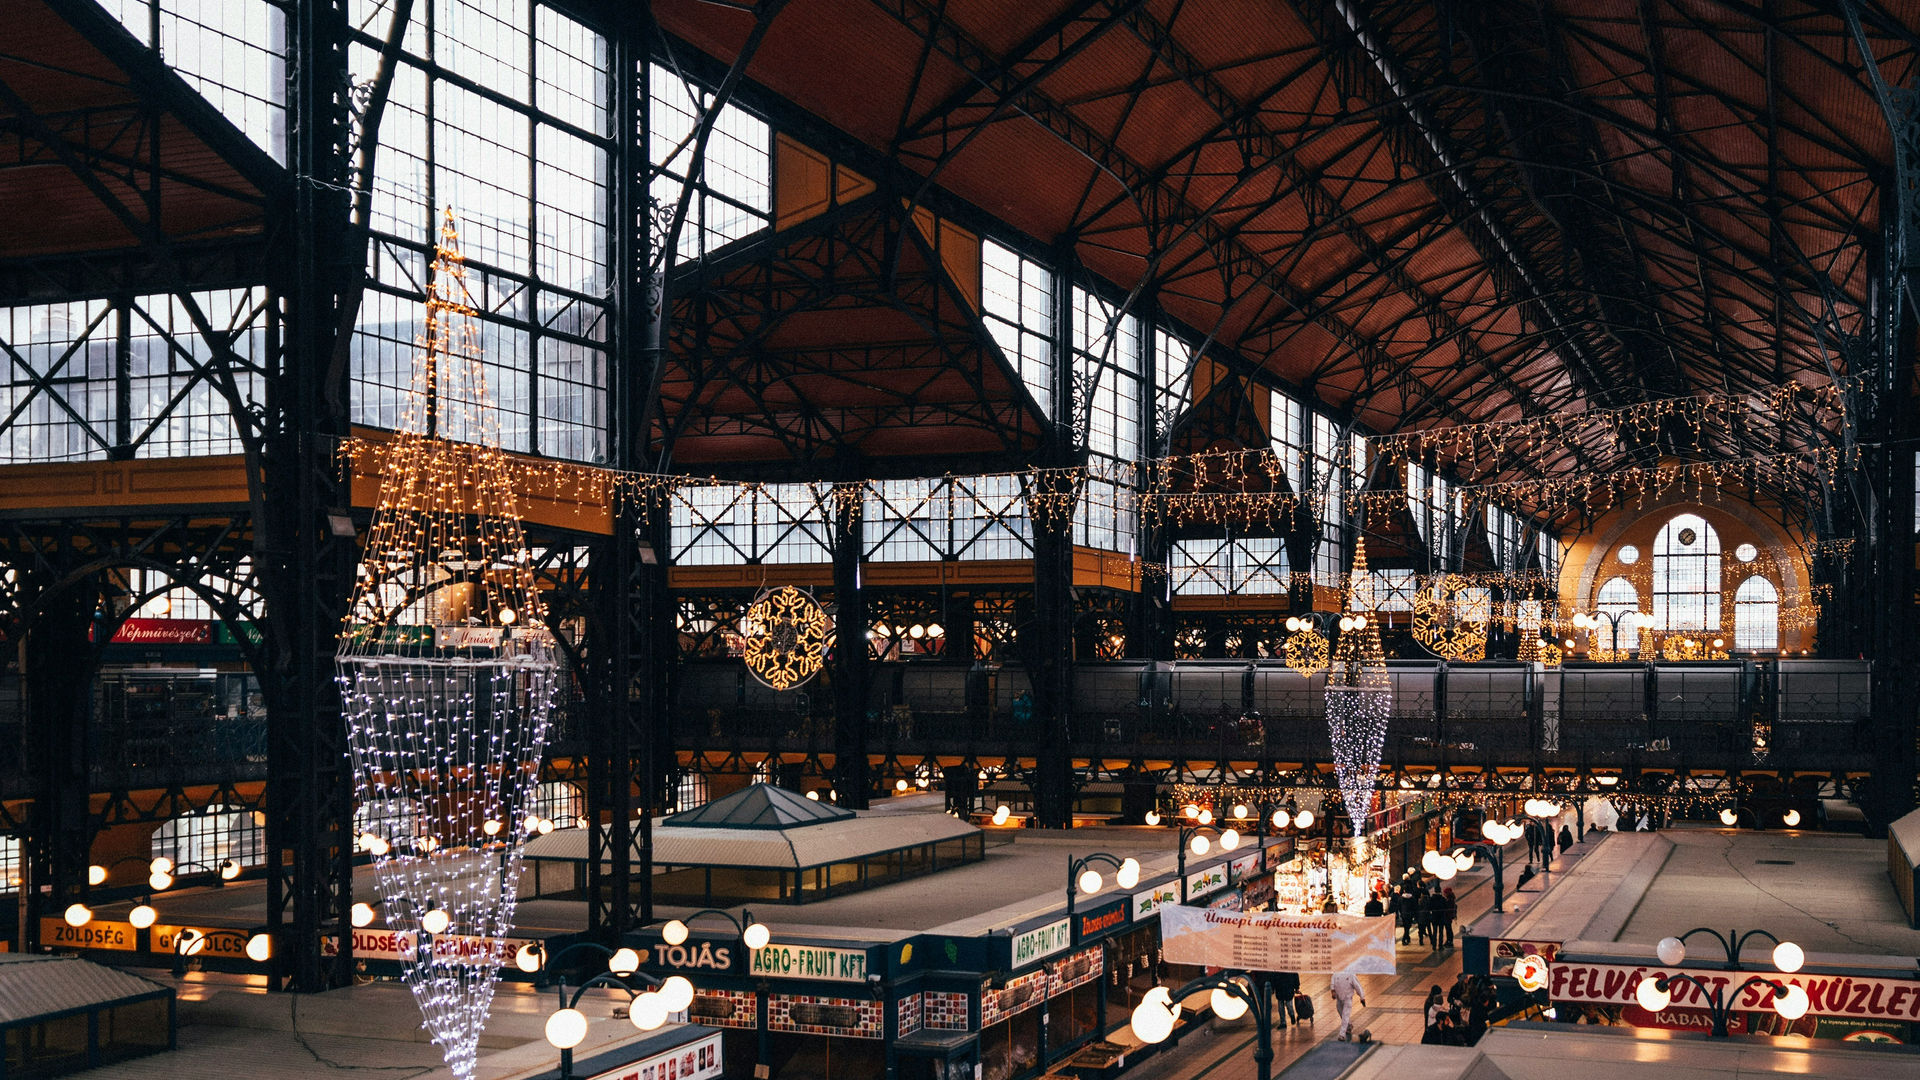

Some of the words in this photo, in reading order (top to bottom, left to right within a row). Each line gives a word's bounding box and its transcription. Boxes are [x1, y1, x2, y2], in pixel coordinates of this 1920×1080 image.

[1204, 909, 1252, 928] Ünnepi
[1255, 918, 1342, 930] nyitvatartás.
[654, 941, 731, 970] TOJÁS
[1016, 926, 1055, 963] AGRO-FRUIT
[753, 946, 836, 976] AGRO-FRUIT
[840, 952, 867, 980] KFT.
[1551, 965, 1730, 1006] FELVÁOTT
[1741, 975, 1920, 1018] SZKÜZLET
[1655, 1011, 1741, 1029] KABANS
